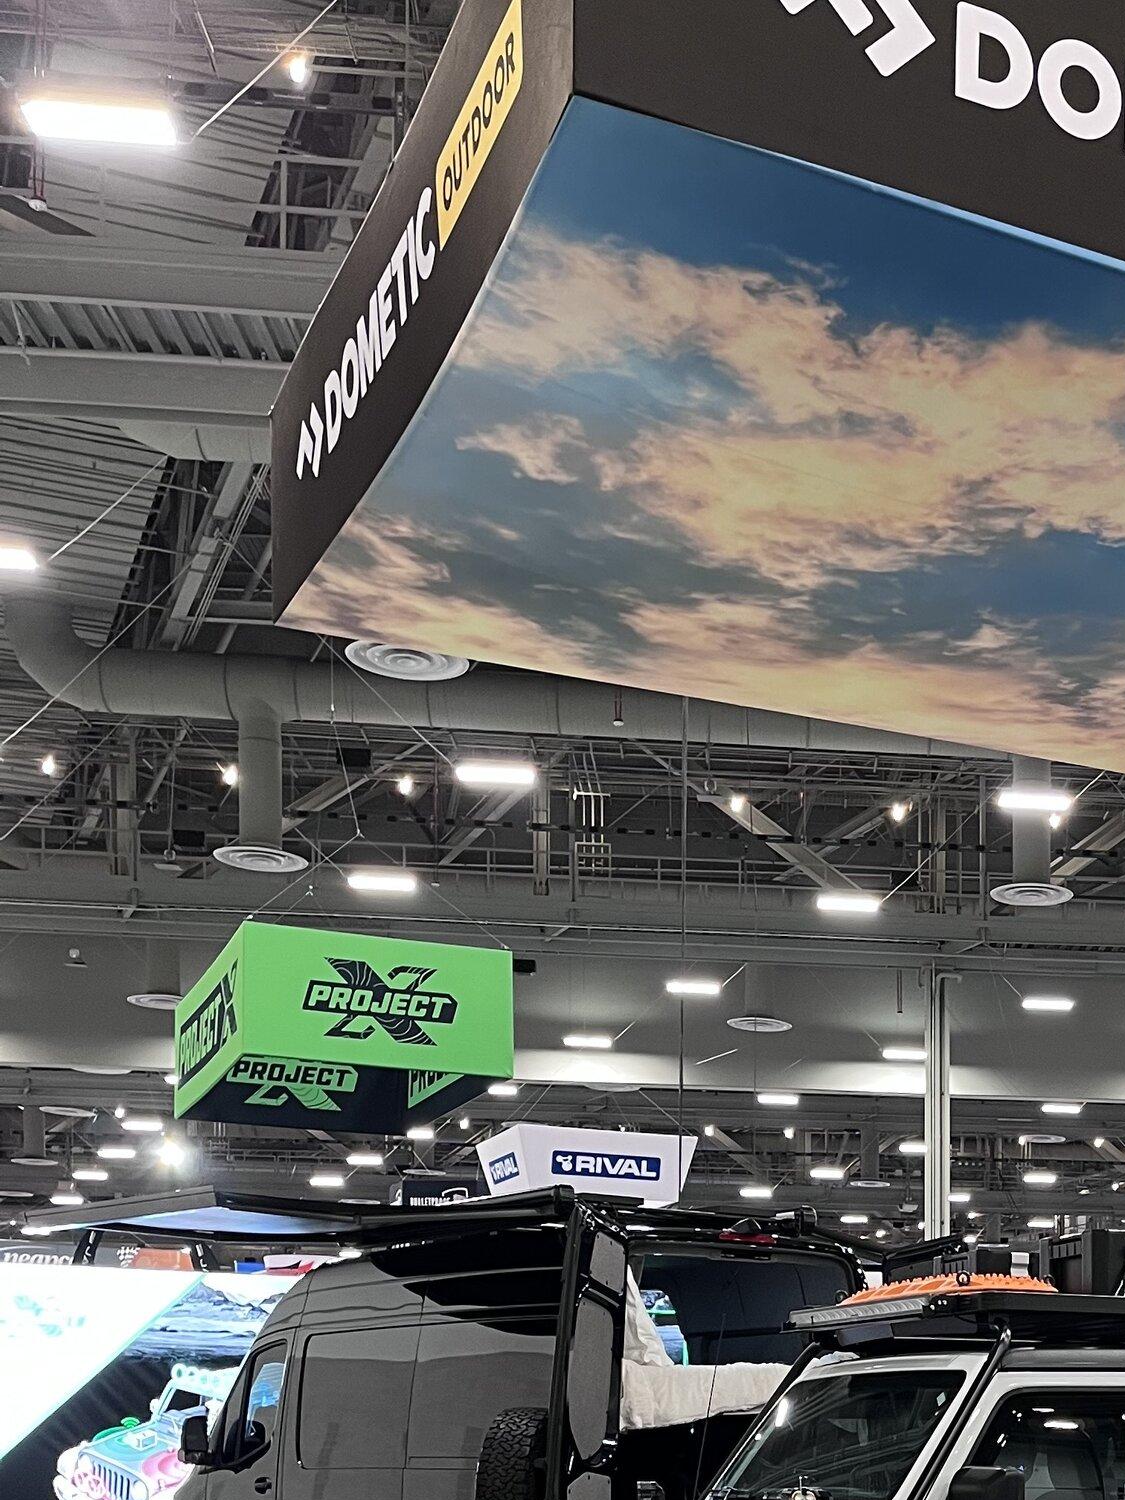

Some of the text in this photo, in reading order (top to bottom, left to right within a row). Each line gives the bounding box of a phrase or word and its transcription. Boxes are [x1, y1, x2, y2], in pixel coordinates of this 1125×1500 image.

[324, 31, 517, 446] DOMETIC OUTDOOR
[308, 984, 453, 1020] PROJECT
[178, 991, 222, 1076] PROJECT
[231, 1059, 350, 1087] PROJECT
[576, 1155, 657, 1177] RIVAL
